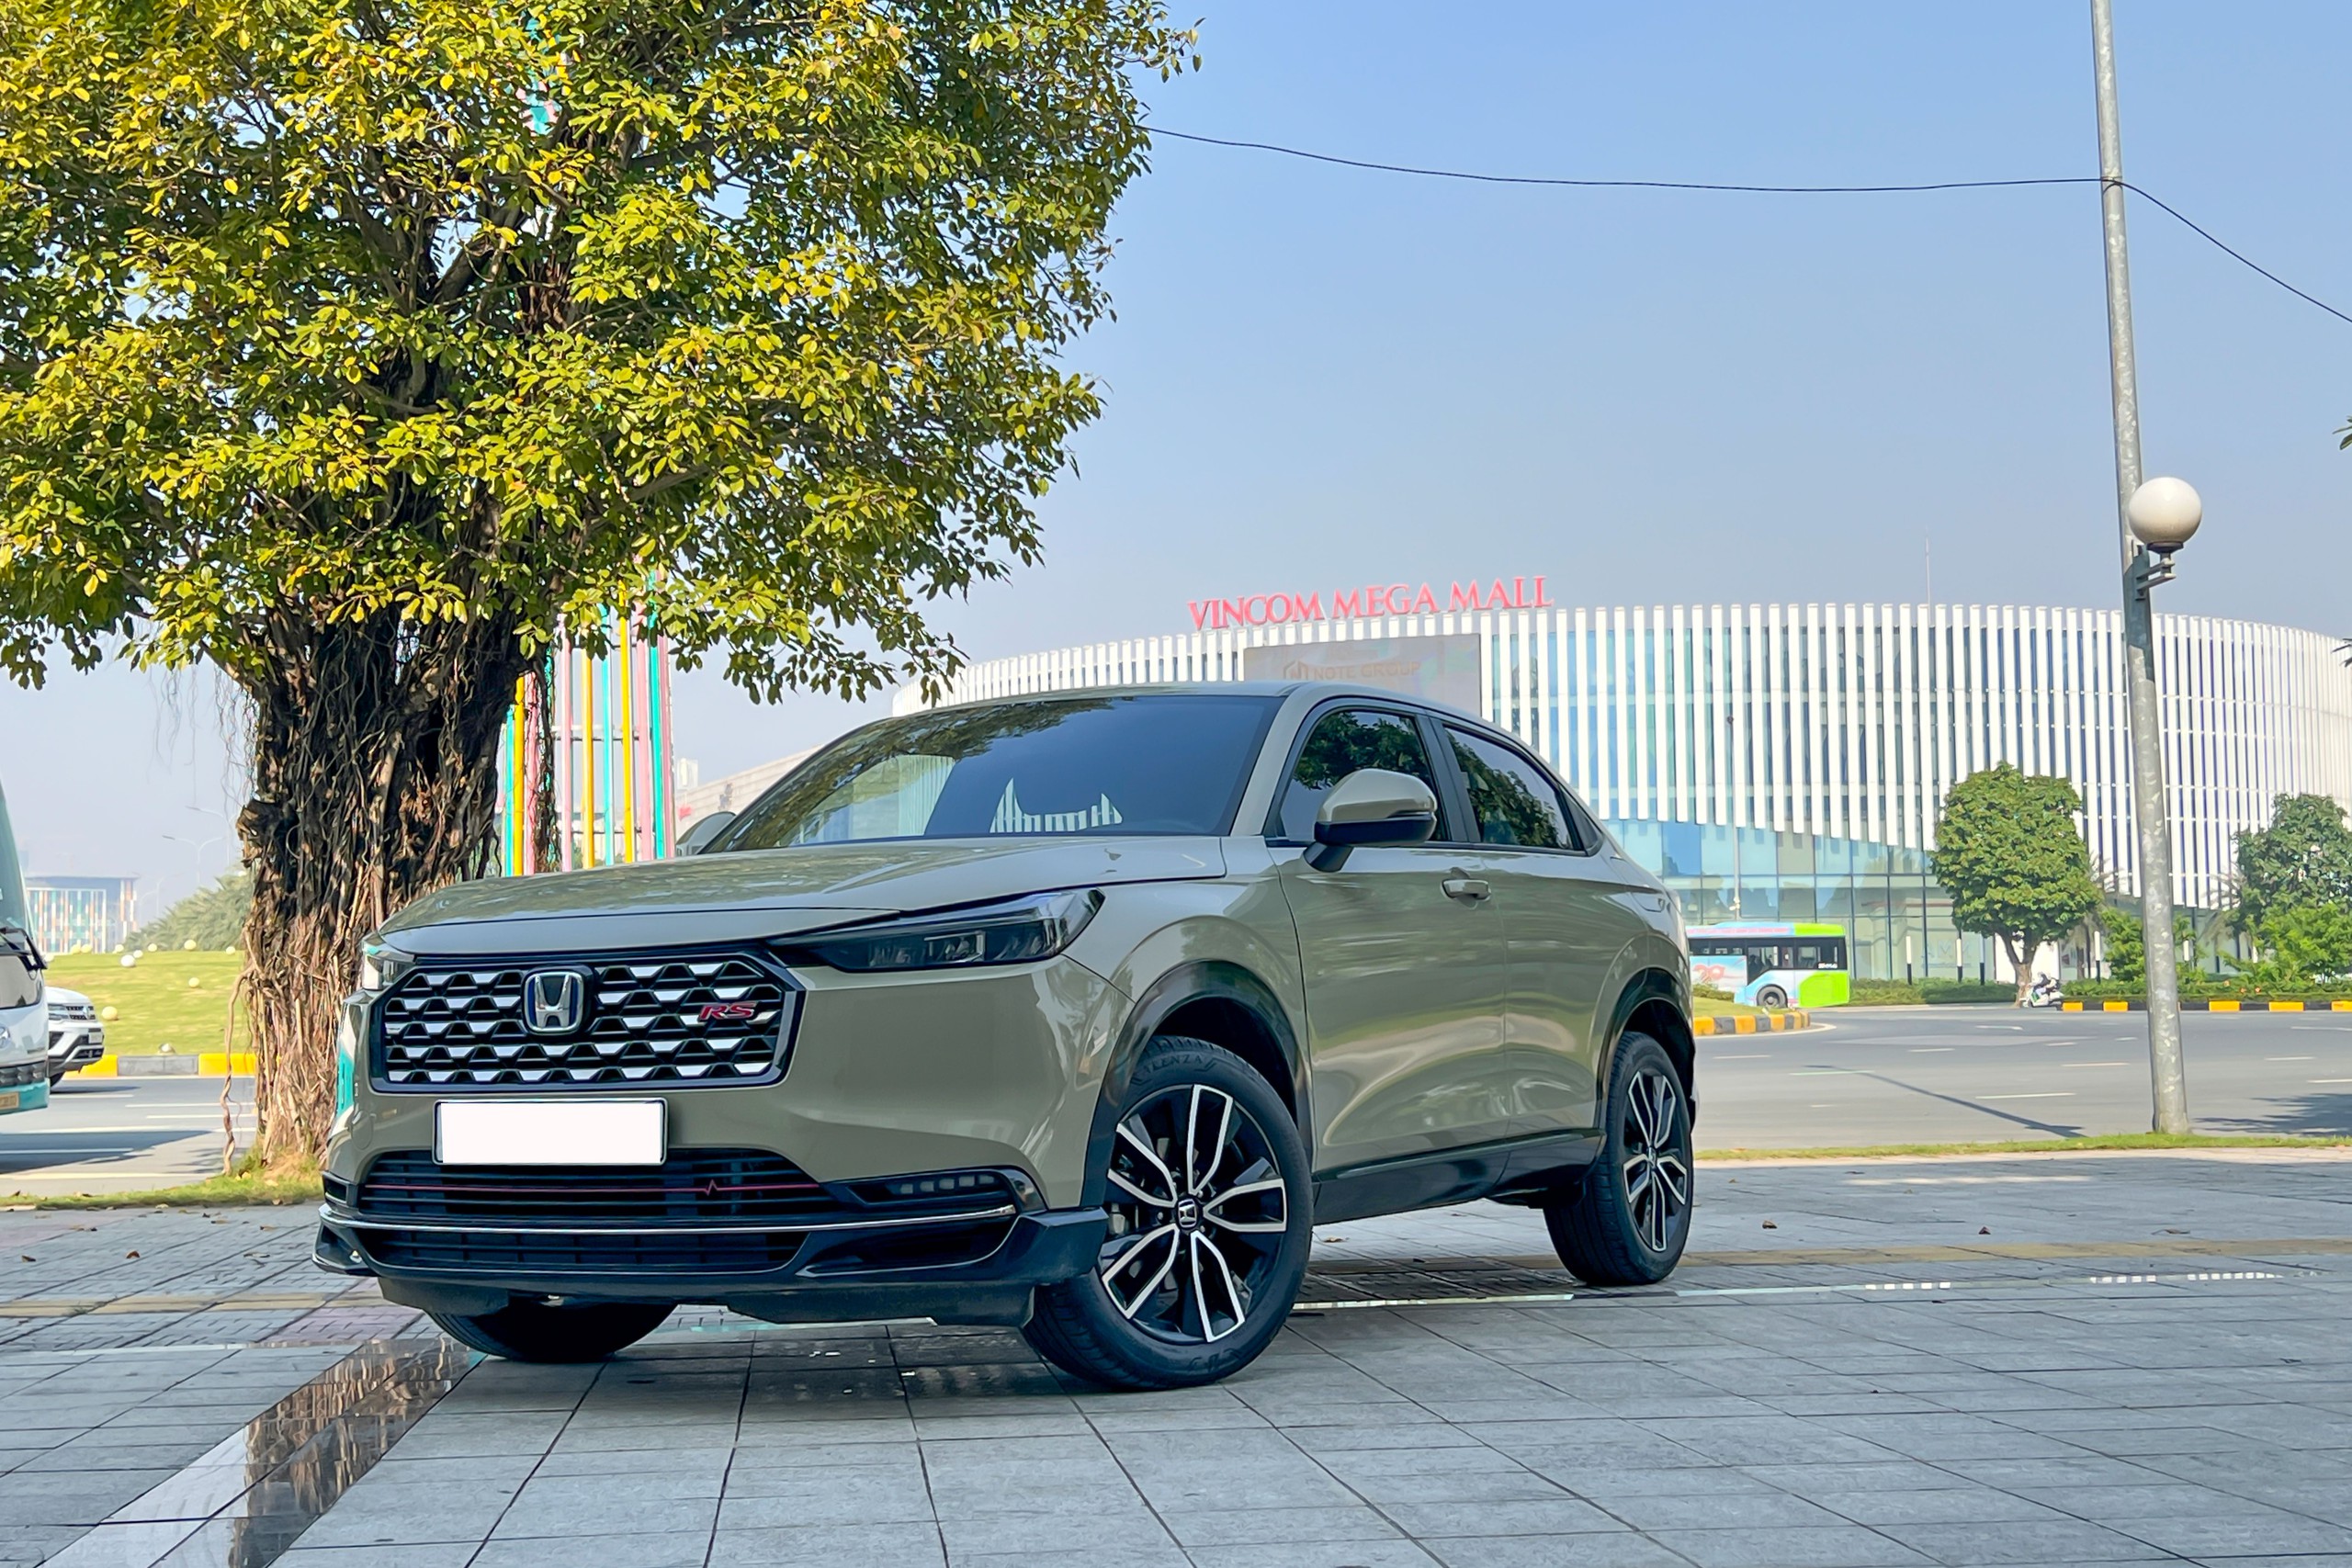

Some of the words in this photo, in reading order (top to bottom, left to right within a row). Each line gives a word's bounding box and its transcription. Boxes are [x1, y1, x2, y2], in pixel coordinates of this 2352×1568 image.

[1187, 590, 1325, 630] VINCOM
[1332, 581, 1441, 619] MEGA
[1448, 575, 1554, 612] MALL
[1360, 660, 1421, 679] GROUP
[698, 1001, 757, 1021] RS
